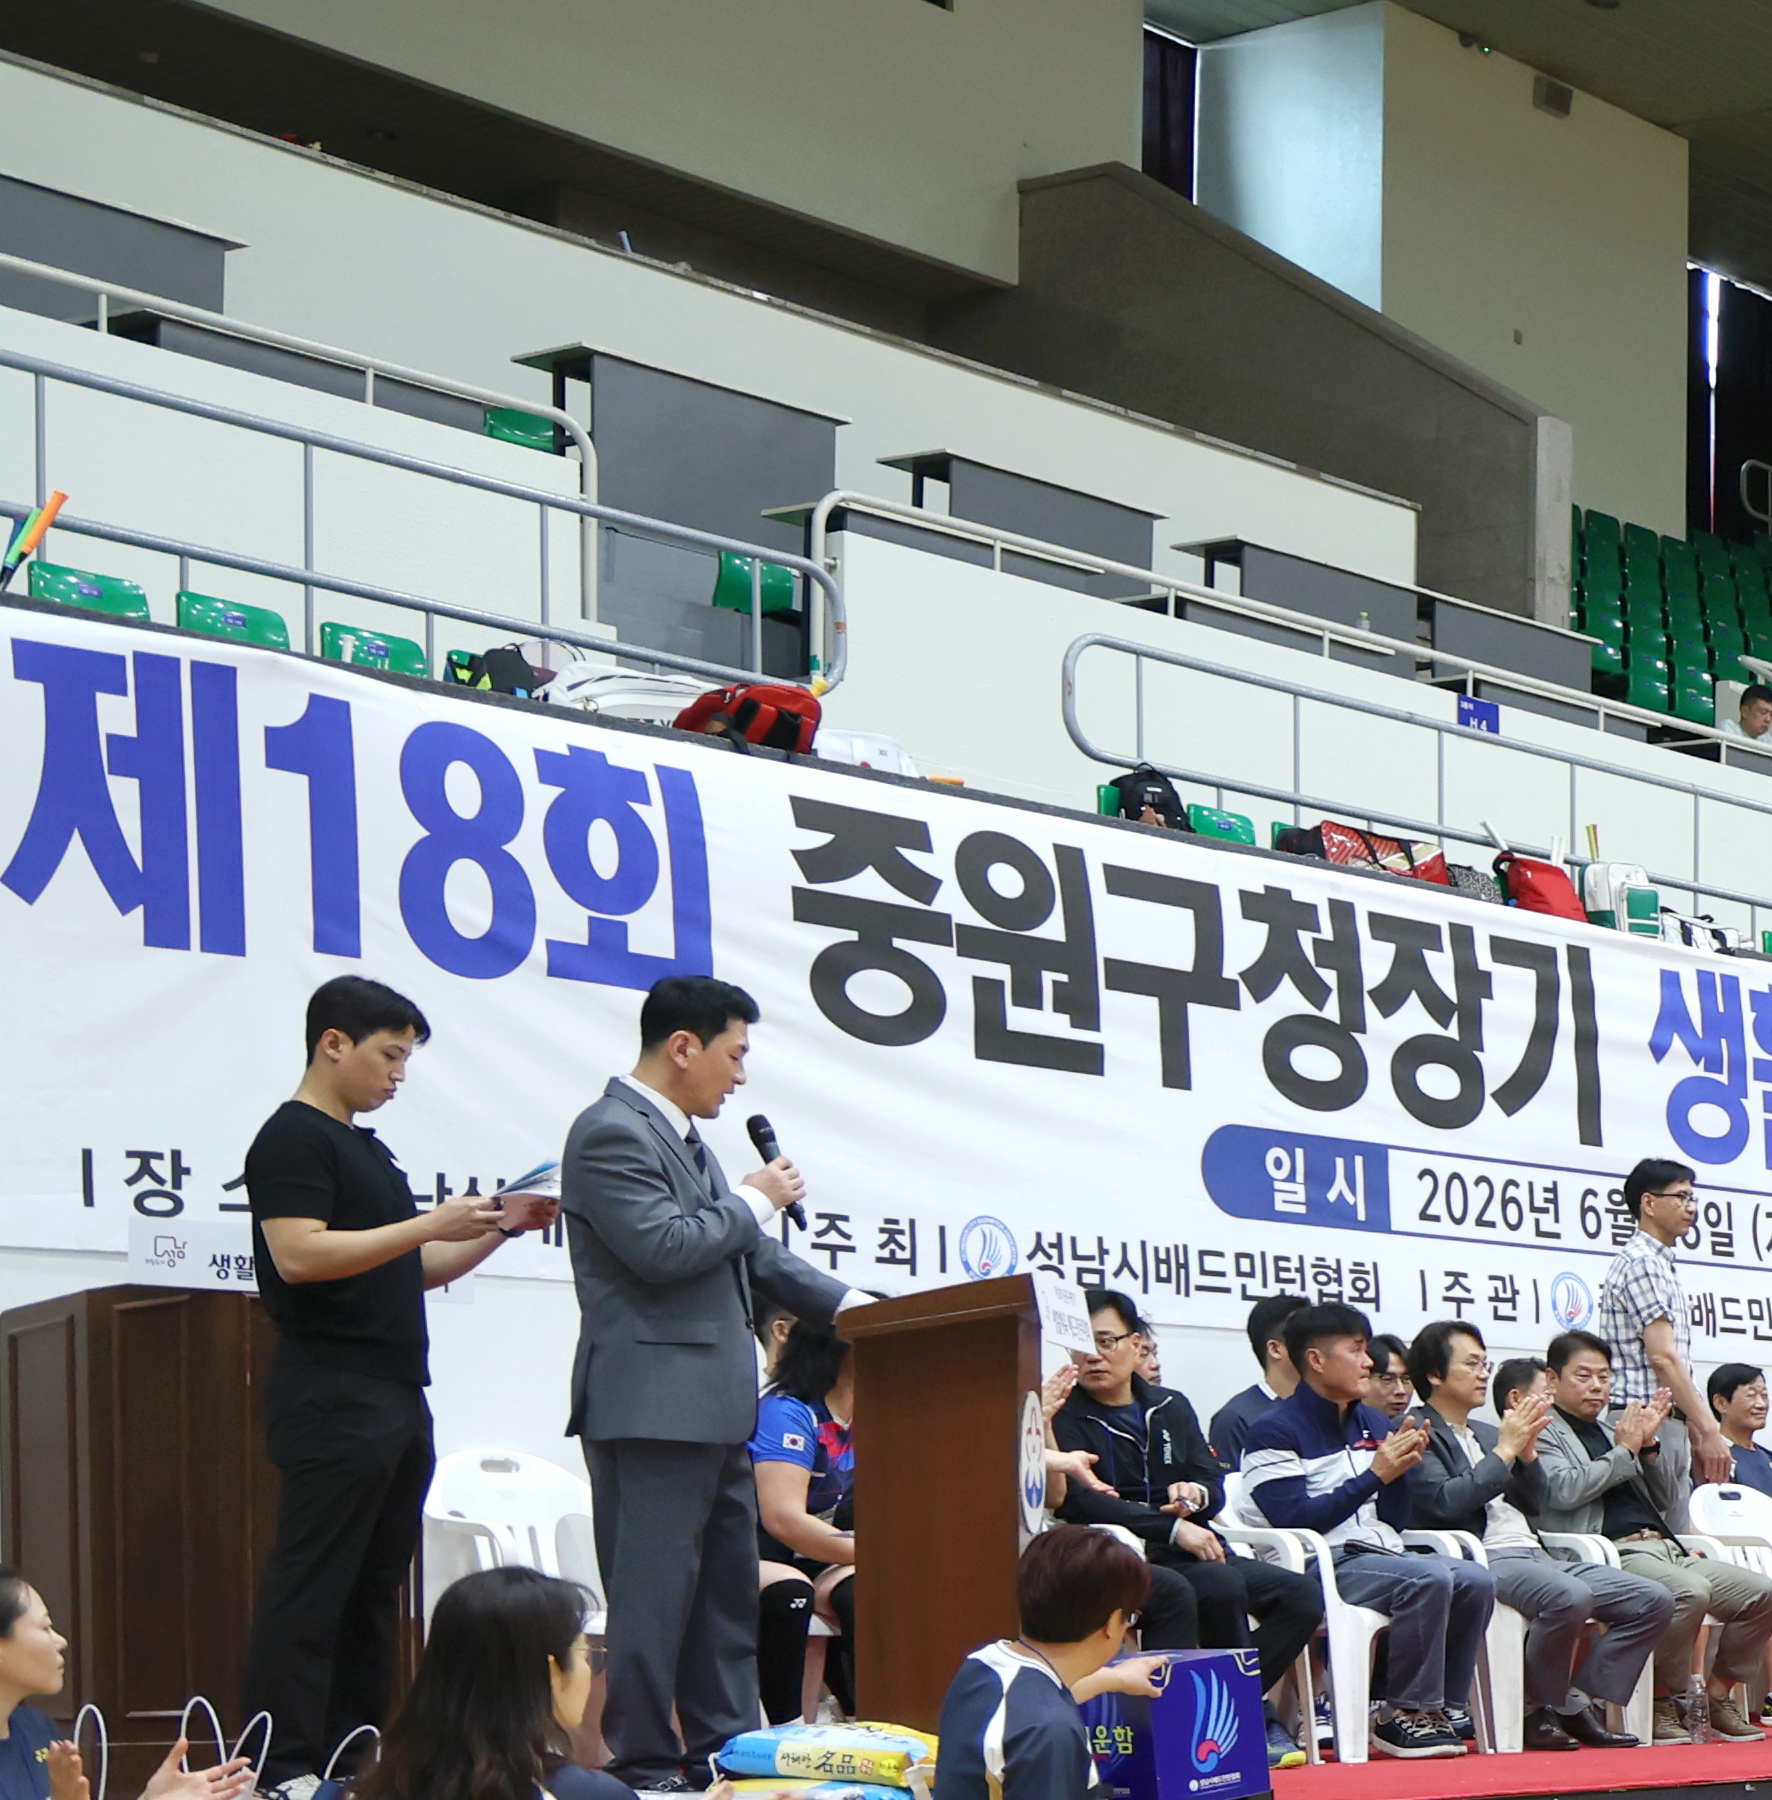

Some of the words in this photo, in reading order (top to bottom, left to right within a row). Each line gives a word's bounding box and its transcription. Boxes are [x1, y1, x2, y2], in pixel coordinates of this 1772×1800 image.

[1, 638, 714, 991] 제18회
[789, 795, 1603, 1147] 중원구청장기
[1417, 1168, 1562, 1240] 2026년
[1681, 1201, 1735, 1258] 8일
[1026, 1231, 1381, 1313] 성남시배드민턴협회
[813, 1751, 857, 1776] 名品
[1085, 1724, 1134, 1755] 운함
